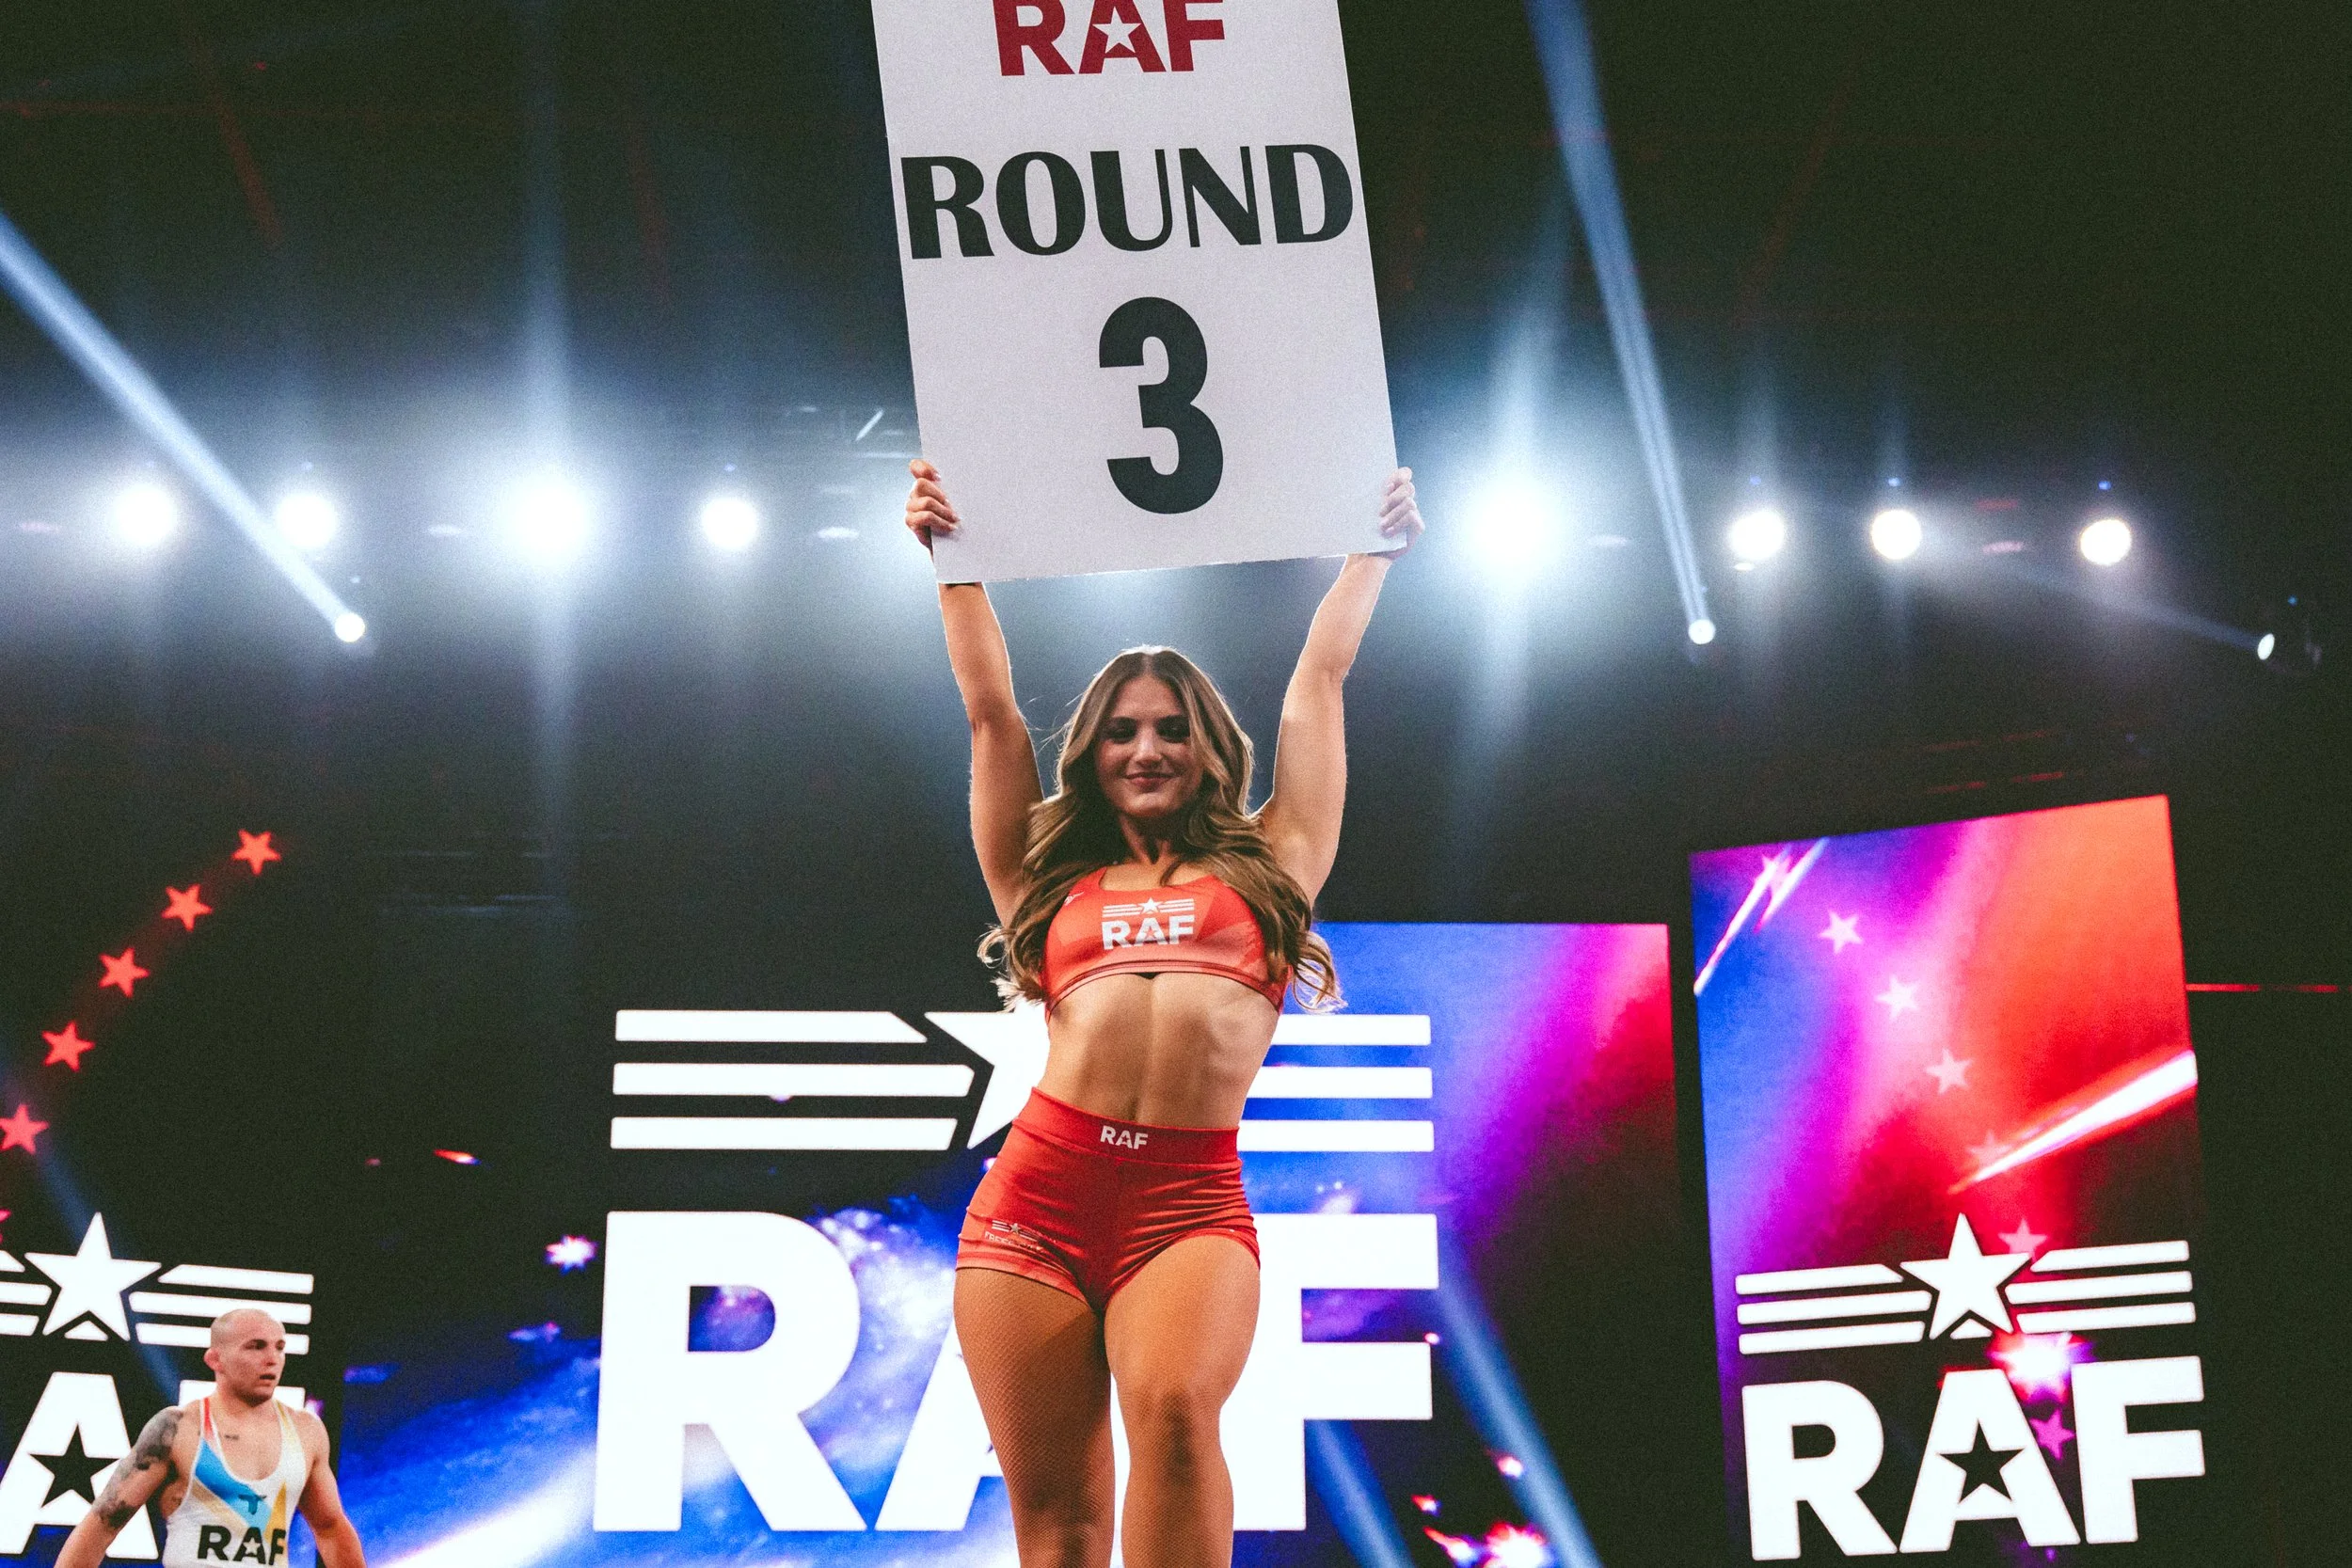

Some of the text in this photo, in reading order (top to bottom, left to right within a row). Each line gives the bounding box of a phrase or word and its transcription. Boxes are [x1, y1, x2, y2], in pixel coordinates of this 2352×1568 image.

[993, 0, 1225, 76] RAF
[900, 144, 1354, 260] ROUND
[1099, 296, 1224, 515] 3
[1101, 914, 1195, 950] RAF
[1100, 1125, 1149, 1149] RAF
[1741, 1355, 2205, 1560] RAF
[197, 1525, 287, 1566] RAF
